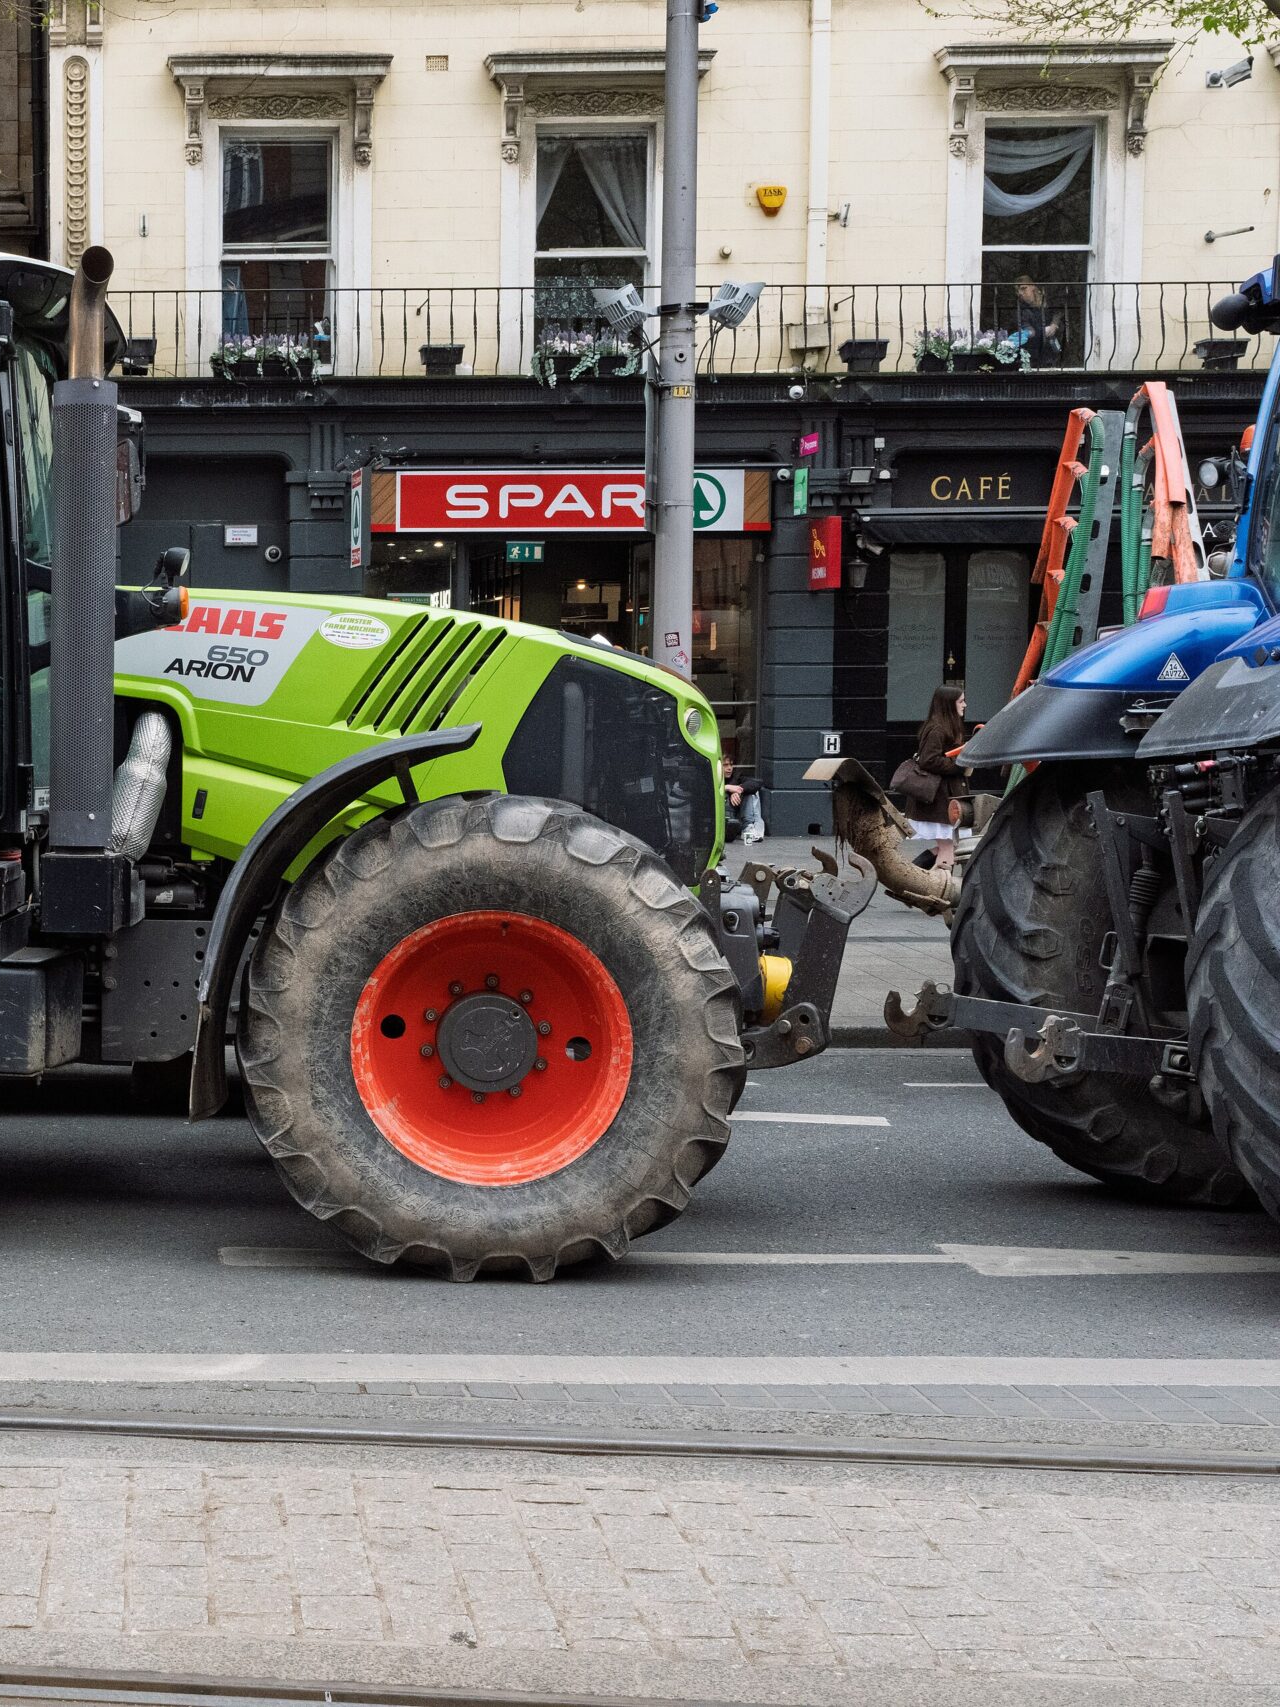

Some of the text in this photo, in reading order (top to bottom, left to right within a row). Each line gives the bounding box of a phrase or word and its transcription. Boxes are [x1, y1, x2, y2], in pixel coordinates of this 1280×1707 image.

[930, 472, 1012, 501] CAFÉ
[445, 483, 646, 519] SPAR
[207, 645, 270, 667] 650
[163, 658, 257, 683] ARION
[827, 737, 837, 751] H
